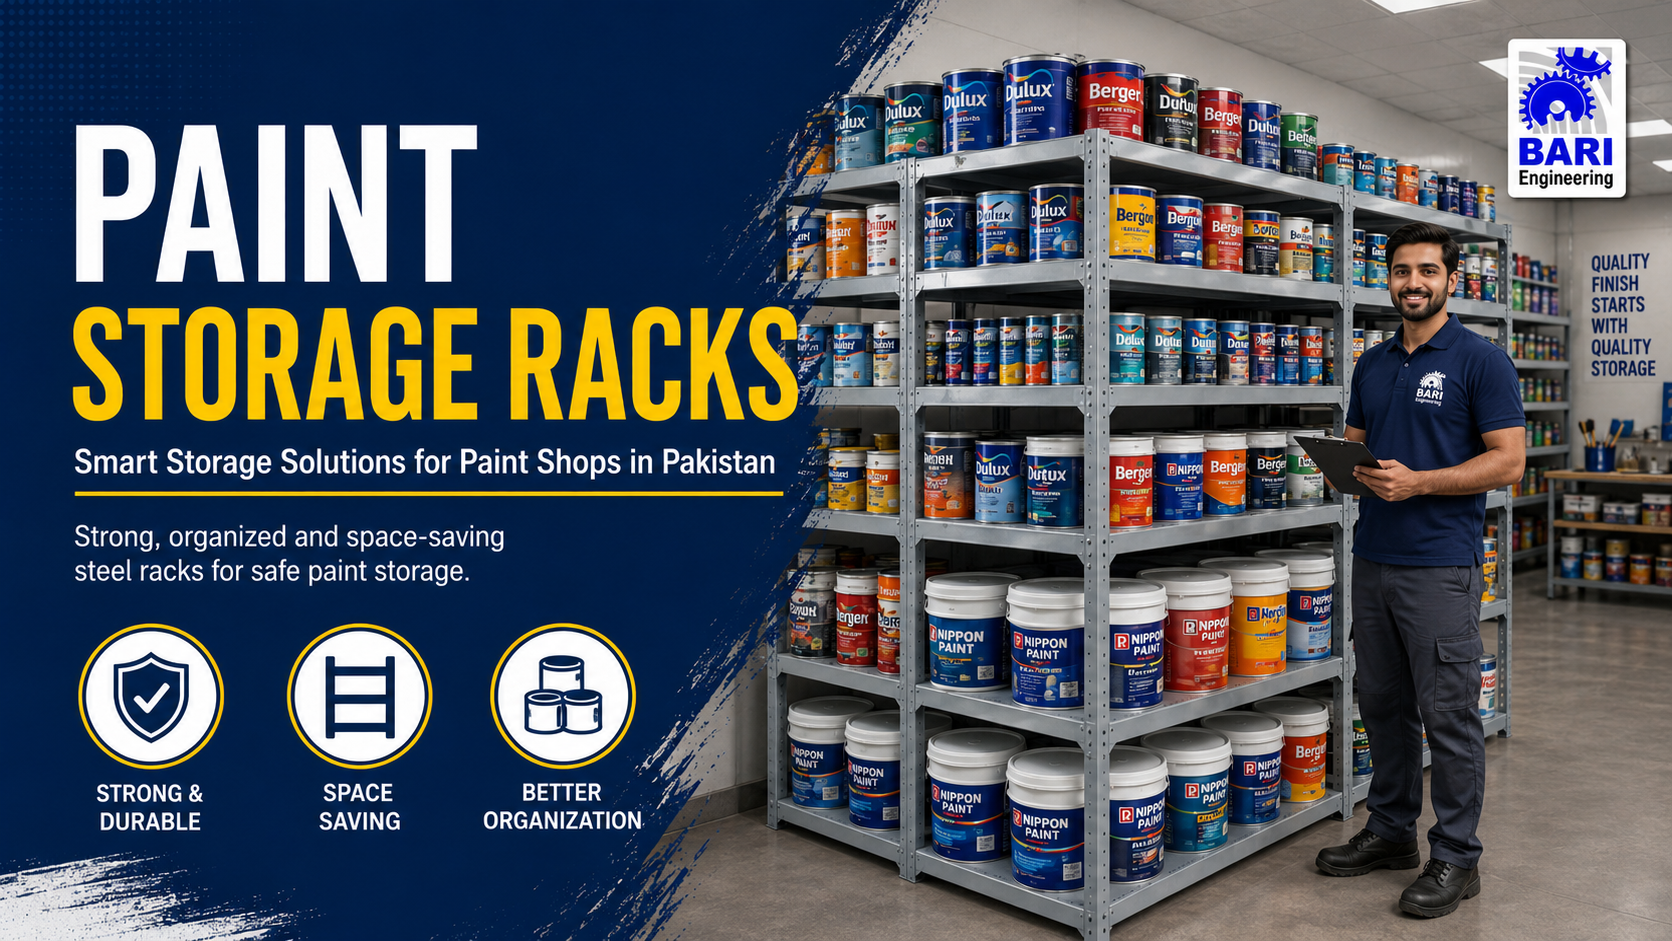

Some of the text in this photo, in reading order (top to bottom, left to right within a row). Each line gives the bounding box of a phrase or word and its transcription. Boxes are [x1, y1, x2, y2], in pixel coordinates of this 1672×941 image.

[1005, 80, 1055, 100] Dulux
[1089, 82, 1142, 104] Berger
[943, 91, 989, 112] Dulux
[885, 103, 925, 122] Dulux
[834, 114, 869, 131] Dulux
[1031, 203, 1067, 219] Dulux
[924, 215, 954, 230] Dulux
[1591, 252, 1650, 273] QUALITY
[1592, 275, 1639, 293] FINISH
[1591, 296, 1645, 313] STARTS
[1591, 317, 1628, 334] WITH
[1591, 338, 1652, 357] QUALITY
[1591, 360, 1656, 377] STORAGE
[1416, 387, 1444, 401] BARI
[976, 460, 1012, 477] Dulux
[1177, 461, 1204, 476] NIPPO
[937, 628, 985, 643] NIPPON
[1024, 636, 1068, 649] NIPPON
[1117, 635, 1127, 648] R
[938, 643, 975, 655] PAINT
[1026, 648, 1060, 660] PAINT
[1133, 642, 1161, 657] PAINT
[940, 789, 982, 804] NIPPON
[942, 801, 974, 814] PAINT
[1121, 809, 1131, 821] R
[1023, 813, 1069, 829] NIPPON
[1025, 827, 1060, 841] PAINT
